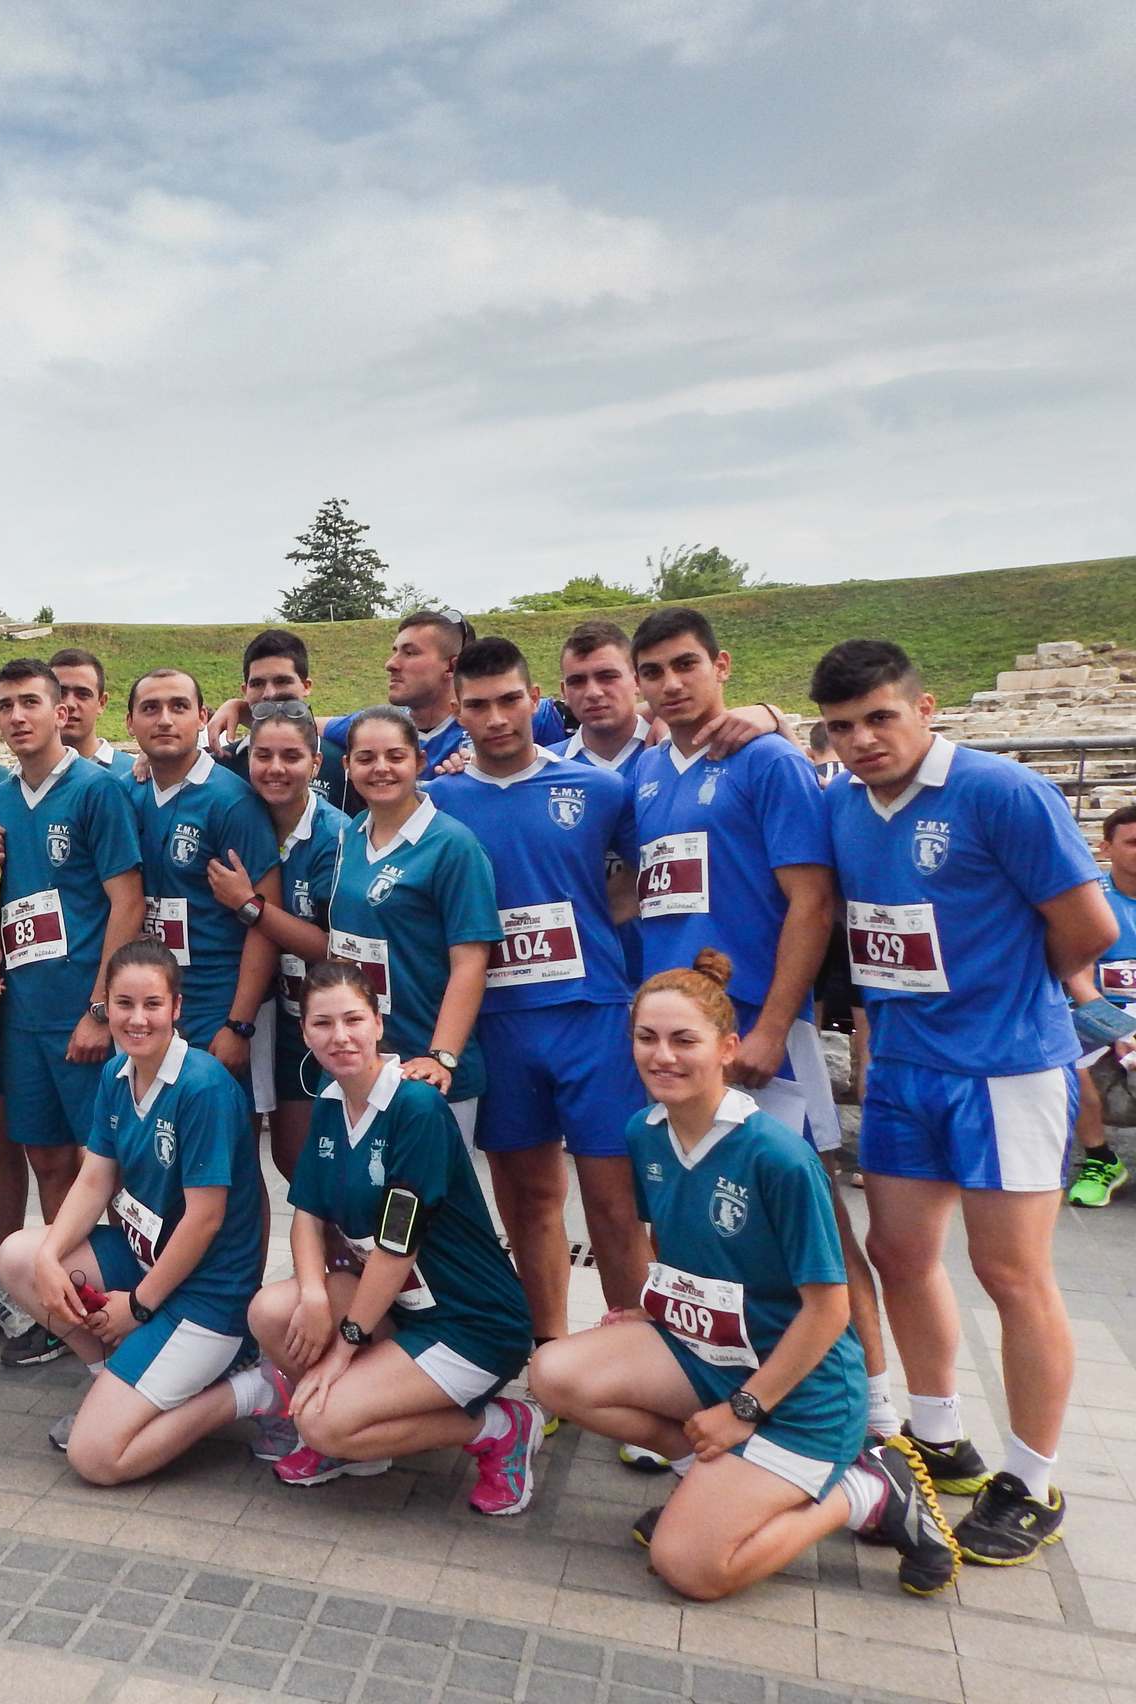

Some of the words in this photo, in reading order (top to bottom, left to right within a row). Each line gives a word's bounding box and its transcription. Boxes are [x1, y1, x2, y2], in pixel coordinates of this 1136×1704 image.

[648, 863, 672, 892] 46
[15, 918, 35, 945] 83
[497, 931, 553, 963] 104
[867, 932, 905, 965] 629
[664, 1299, 714, 1338] 409
